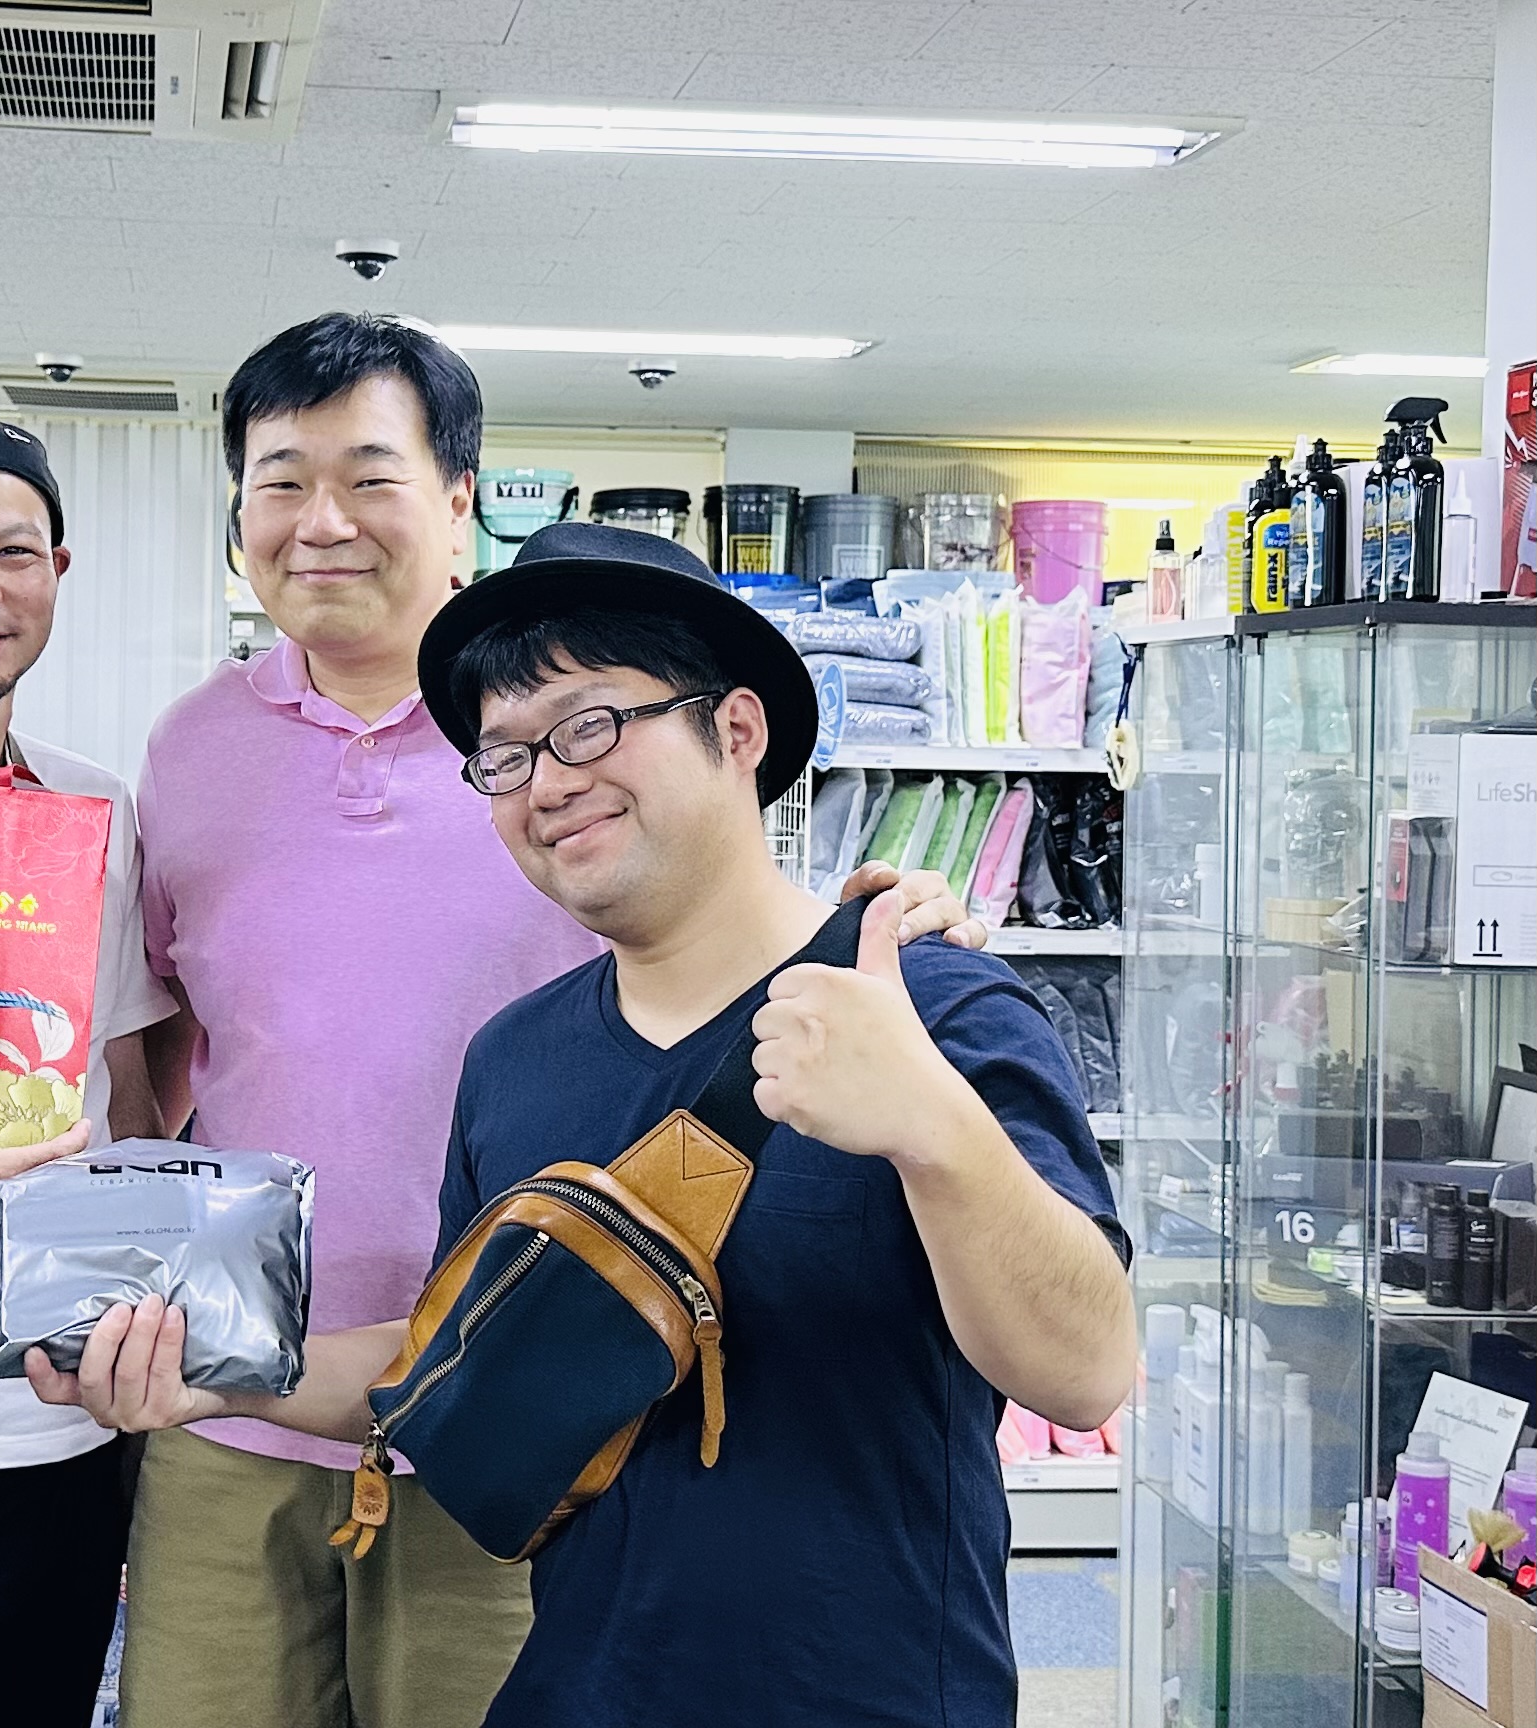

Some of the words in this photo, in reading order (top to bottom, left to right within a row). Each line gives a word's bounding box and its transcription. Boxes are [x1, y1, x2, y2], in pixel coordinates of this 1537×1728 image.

[499, 483, 542, 497] YETI
[15, 920, 57, 934] HIANG
[90, 1177, 151, 1186] CERAMIC
[1275, 1211, 1315, 1243] 16
